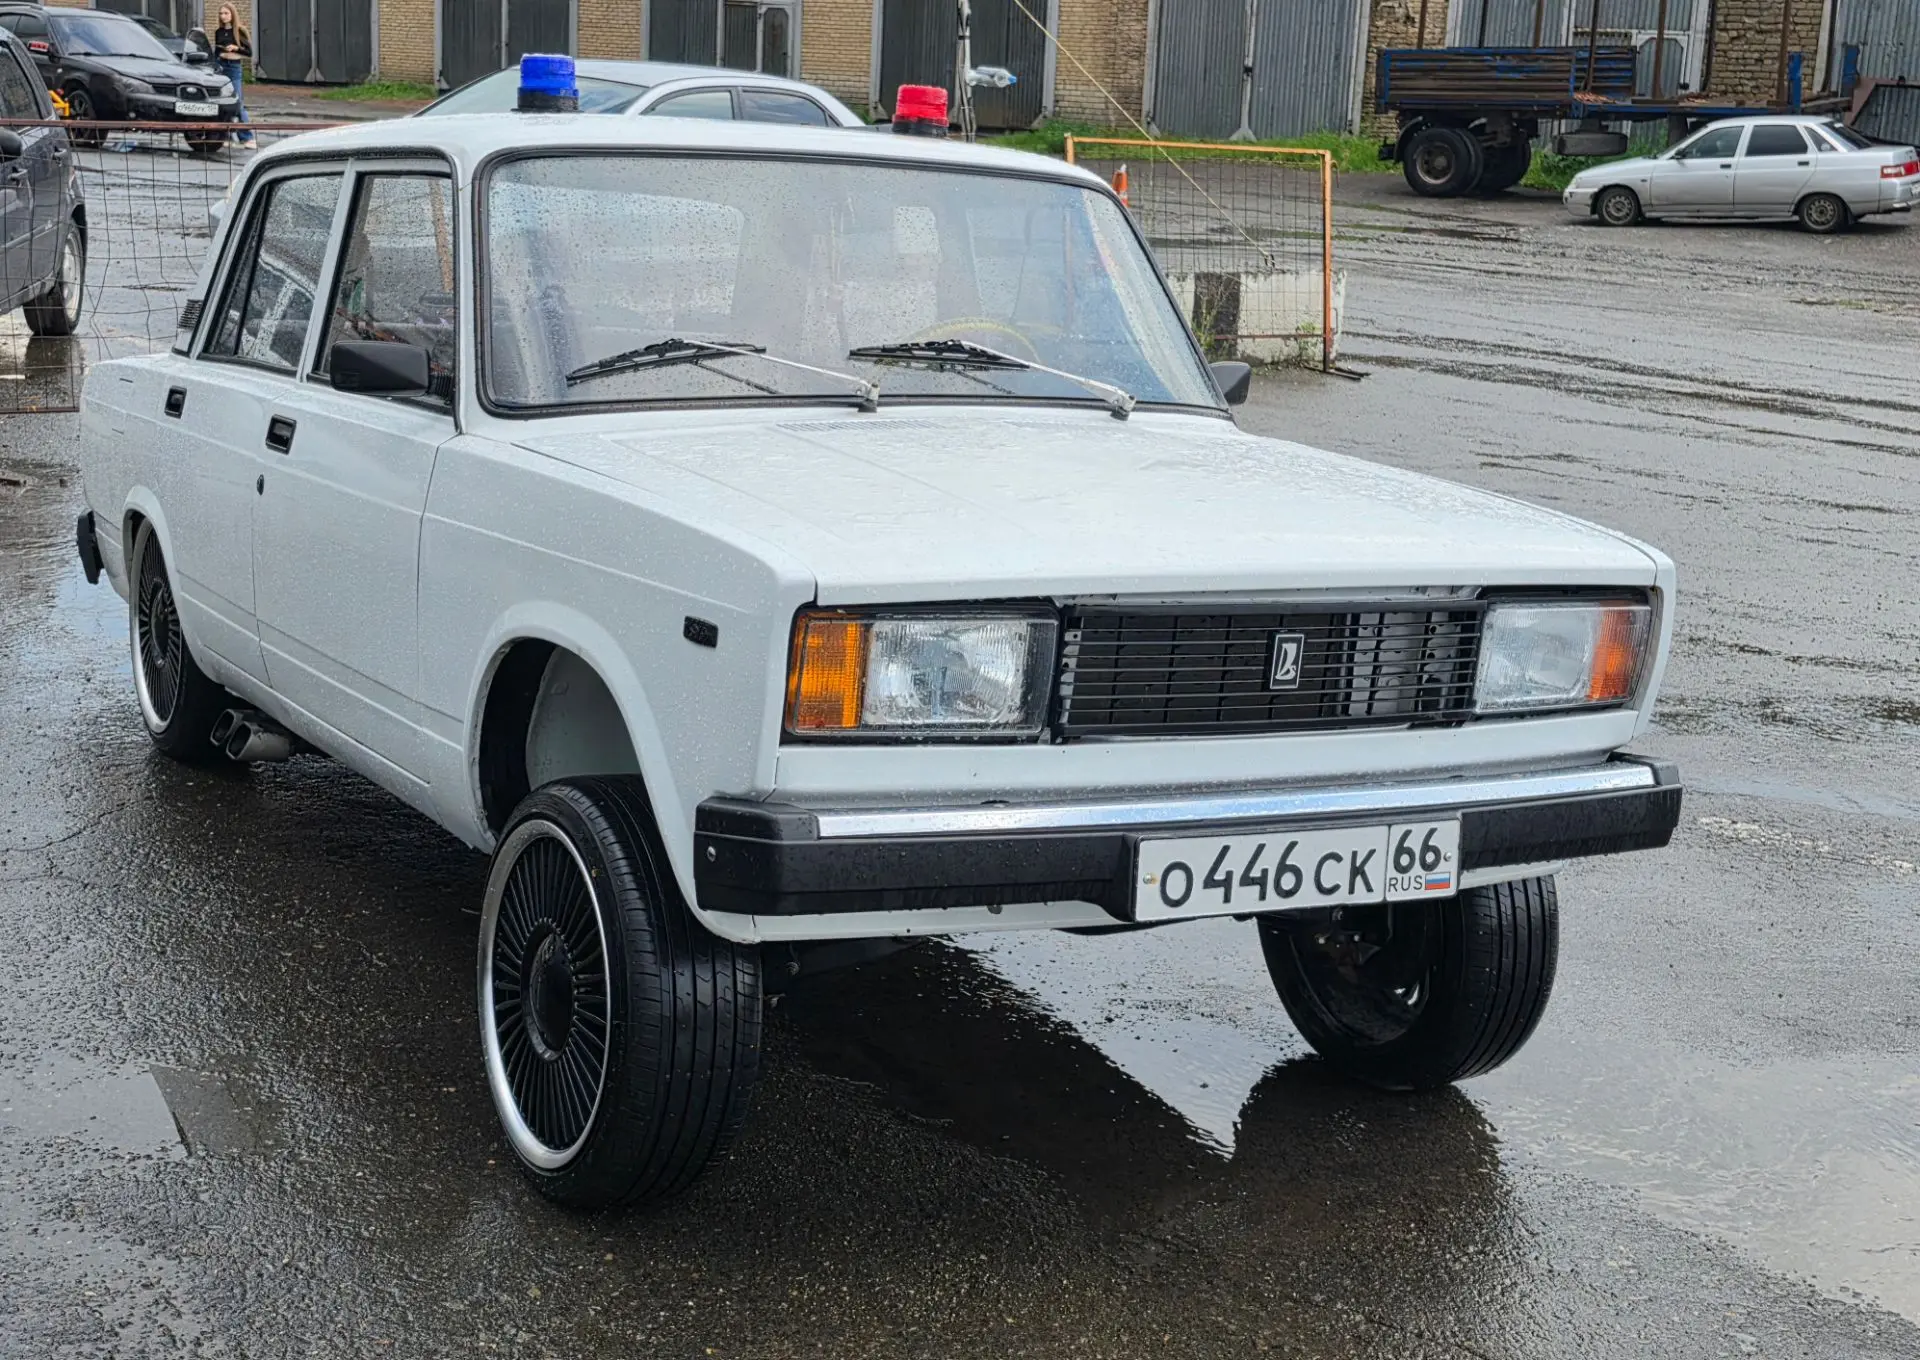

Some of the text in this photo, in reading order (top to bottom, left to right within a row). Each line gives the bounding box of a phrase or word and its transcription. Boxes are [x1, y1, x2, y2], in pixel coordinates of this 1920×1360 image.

[1159, 827, 1442, 908] О446СК 66
[1388, 874, 1423, 893] RUS
